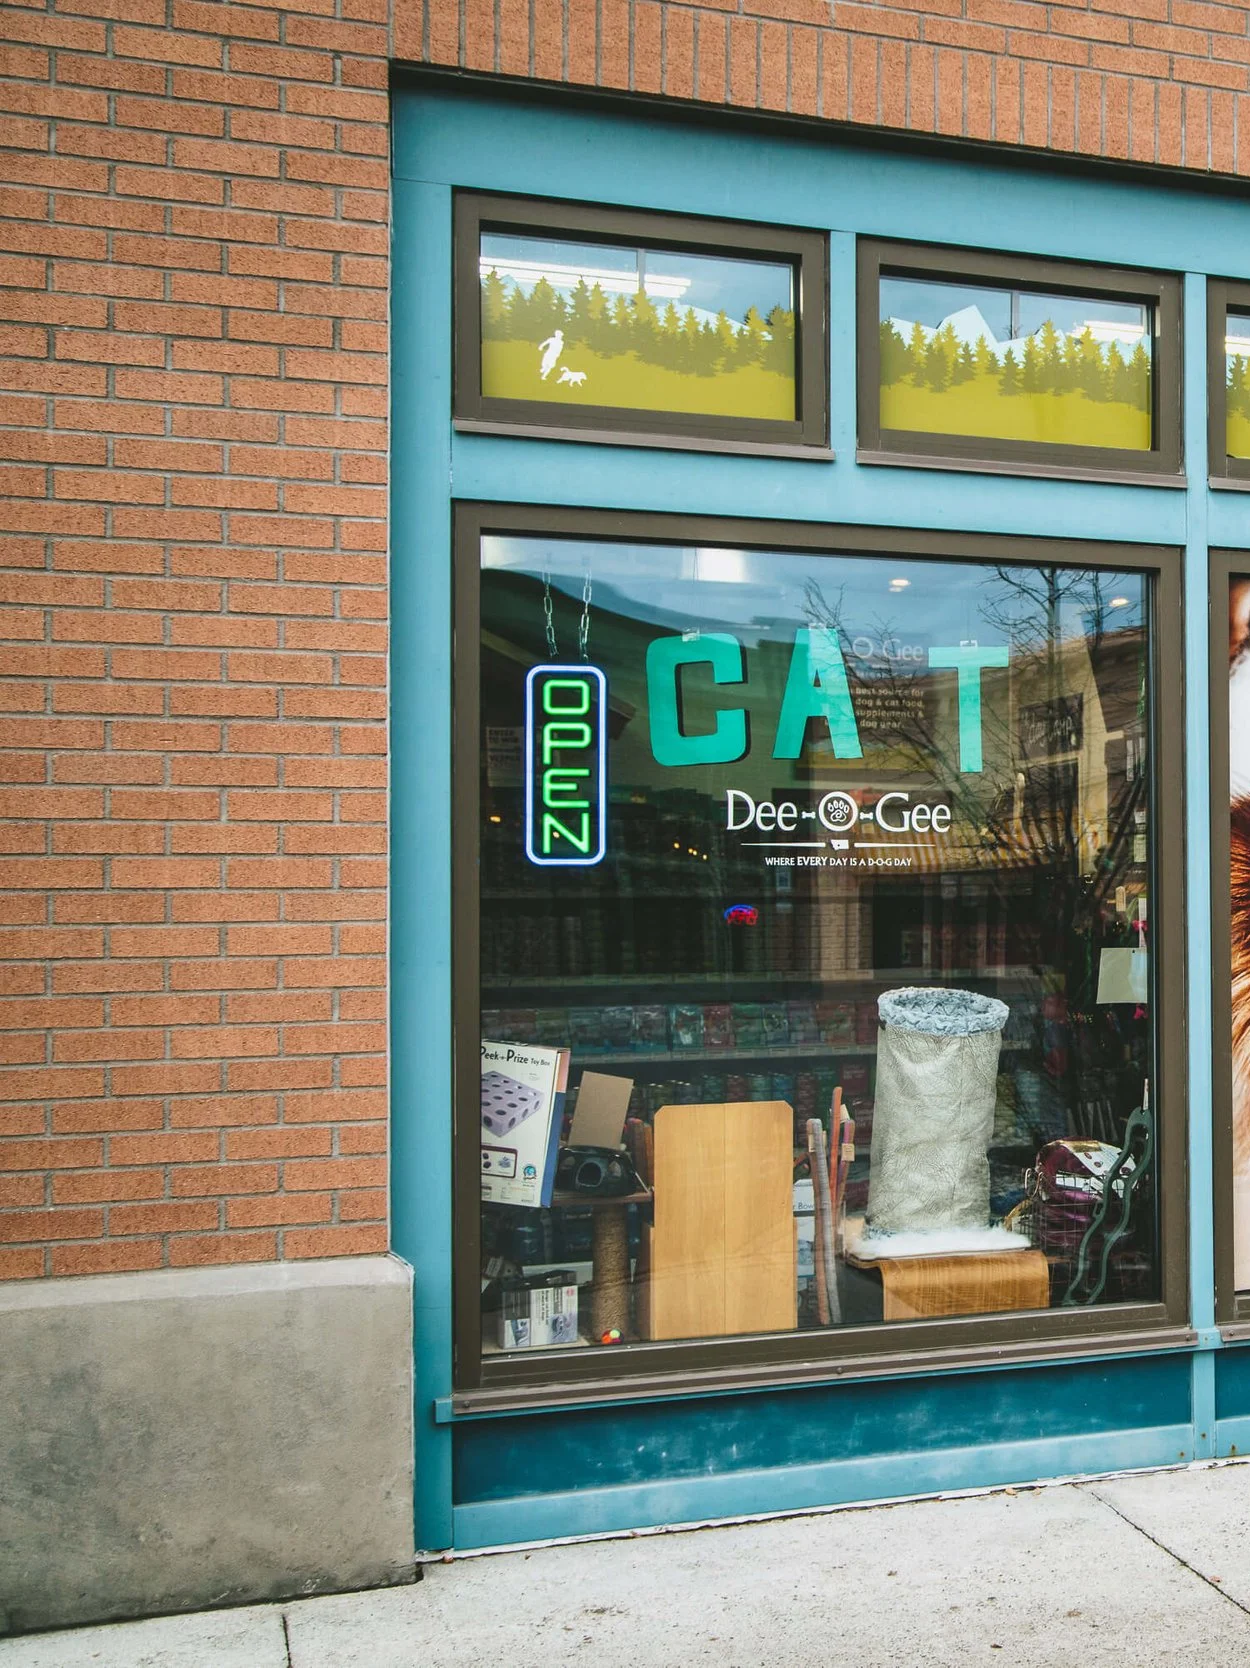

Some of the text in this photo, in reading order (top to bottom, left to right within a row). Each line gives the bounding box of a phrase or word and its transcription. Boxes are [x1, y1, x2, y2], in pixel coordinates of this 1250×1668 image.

[542, 679, 592, 853] OPEN
[765, 856, 912, 867] WHERE EVERY DAY IS A D-O-G DAY
